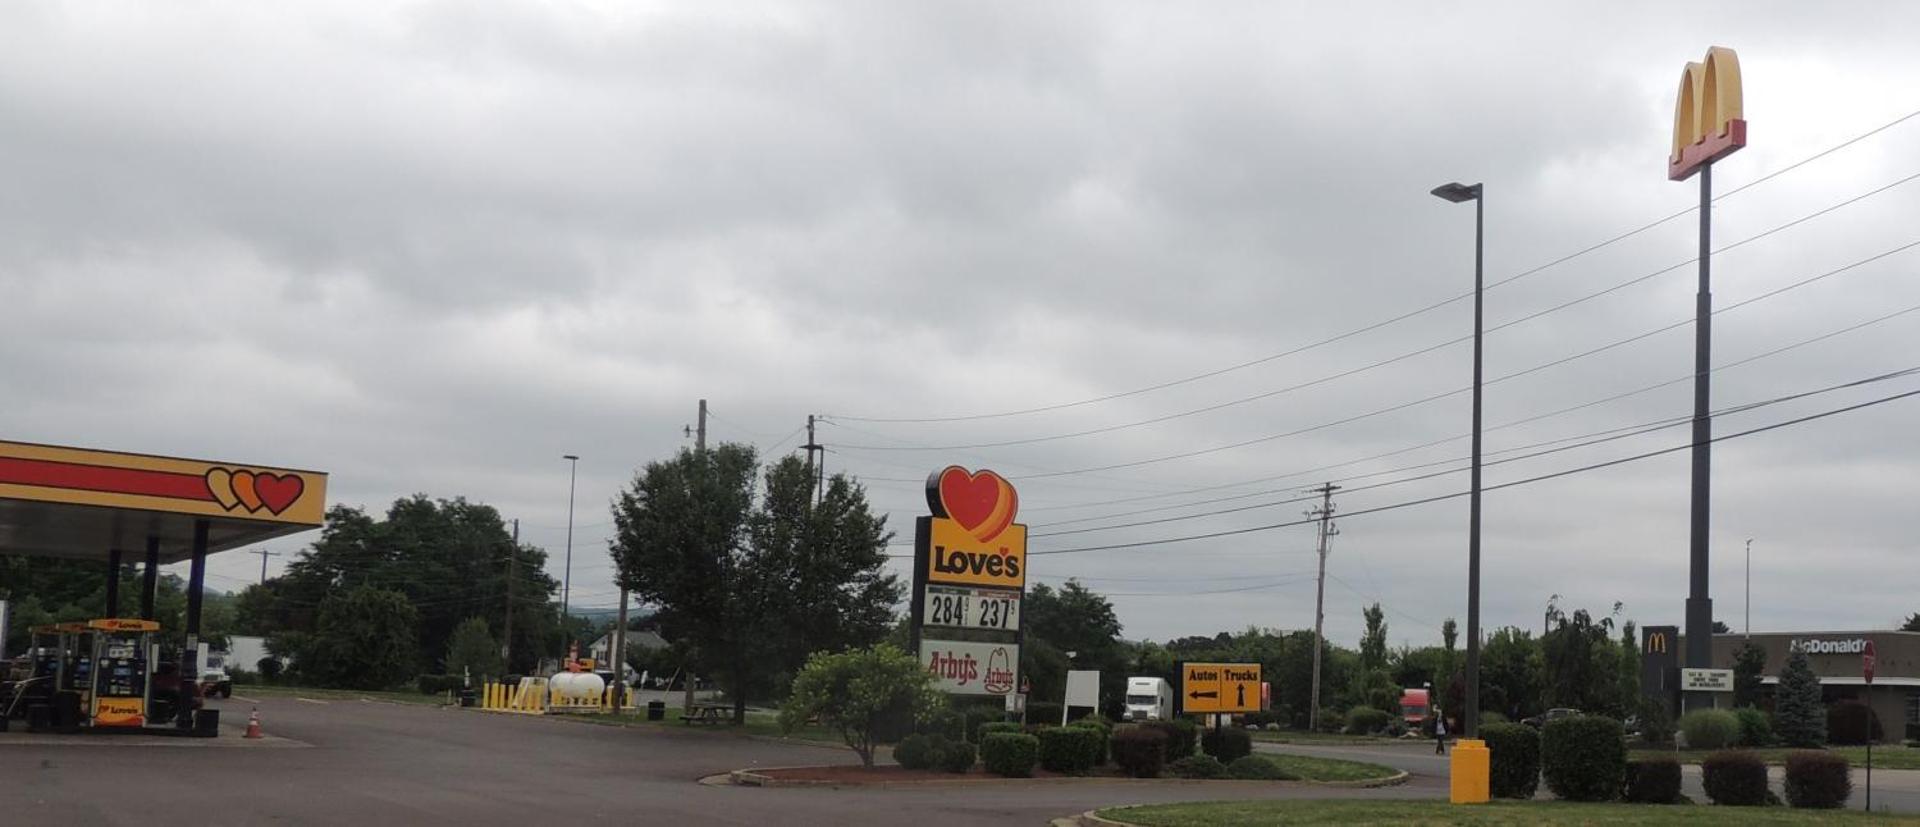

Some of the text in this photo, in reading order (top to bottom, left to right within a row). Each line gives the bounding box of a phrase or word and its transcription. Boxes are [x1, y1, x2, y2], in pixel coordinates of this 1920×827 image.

[934, 546, 1020, 578] Love's
[932, 596, 962, 625] 284
[980, 599, 1009, 628] 237
[929, 651, 978, 685] Arby's
[1189, 668, 1218, 681] Autos
[1224, 669, 1257, 681] Trucks
